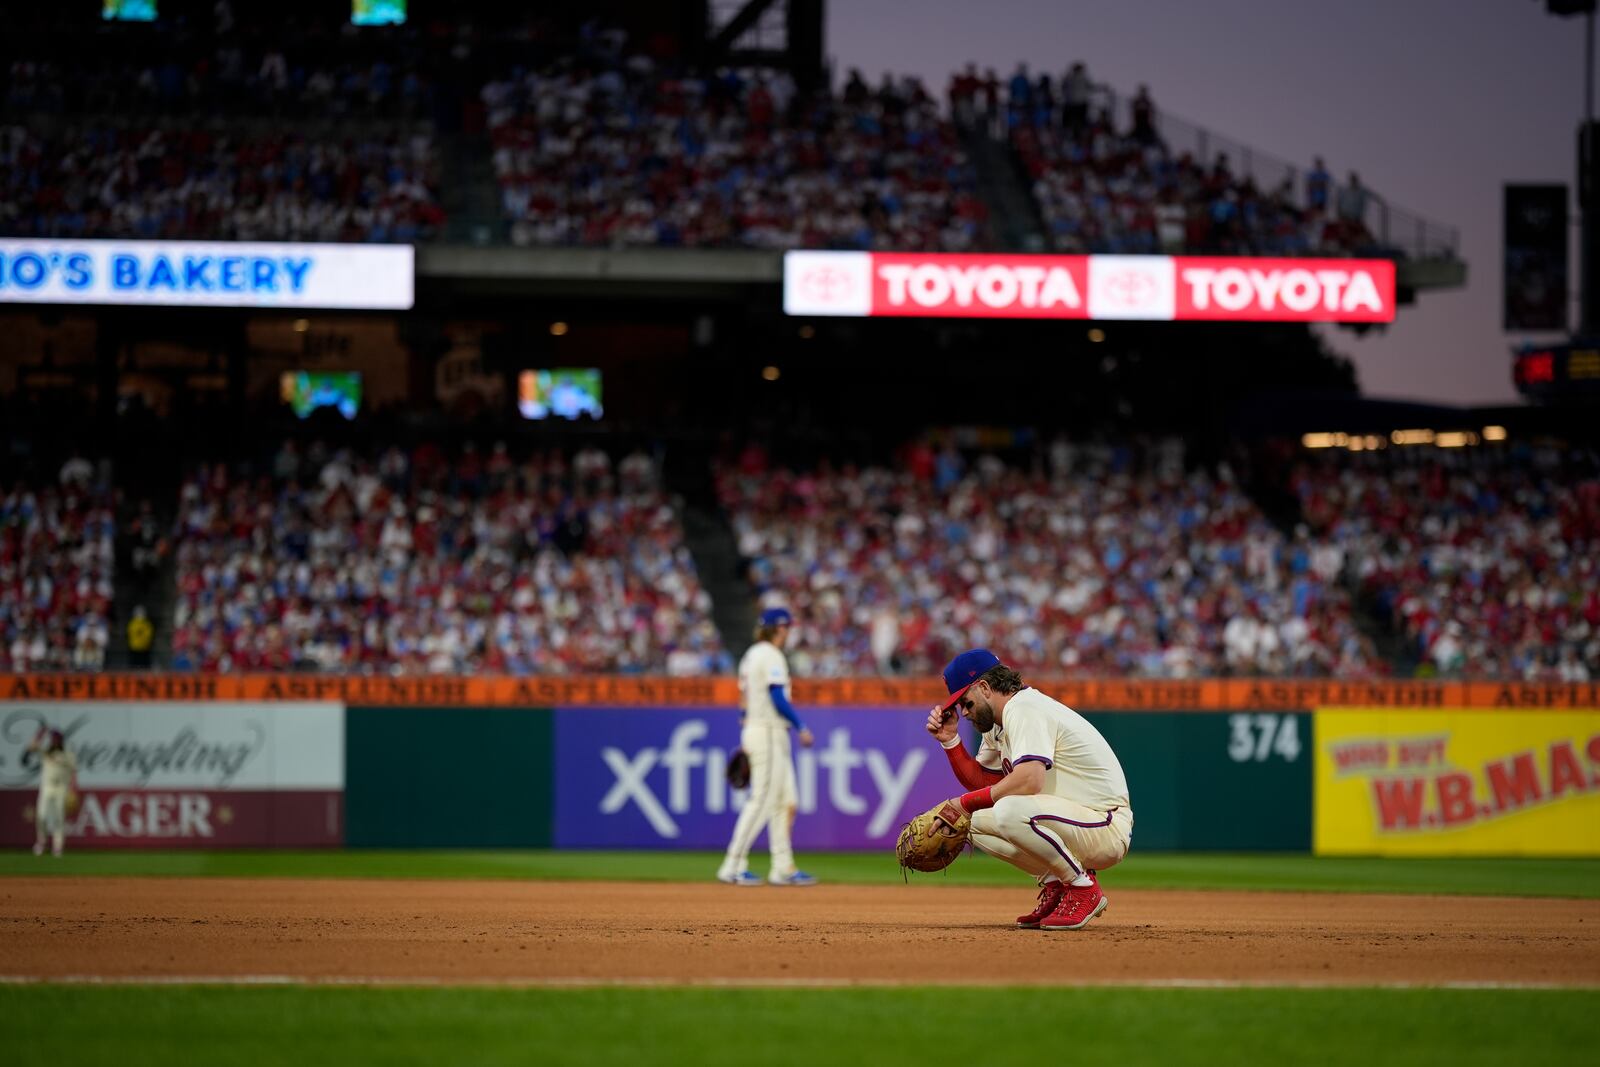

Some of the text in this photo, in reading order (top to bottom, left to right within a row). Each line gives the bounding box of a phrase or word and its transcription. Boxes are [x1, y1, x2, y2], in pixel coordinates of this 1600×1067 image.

[0, 251, 313, 294] O'S BAKERY
[879, 262, 1081, 309] TOYOTA
[1183, 267, 1384, 313] TOYOTA
[10, 677, 217, 700] ASPLUNDH
[263, 677, 468, 702] ASPLUNDH
[1247, 682, 1446, 707] ASPLUNDH
[1228, 714, 1299, 762] 374
[600, 720, 929, 840] xfiity
